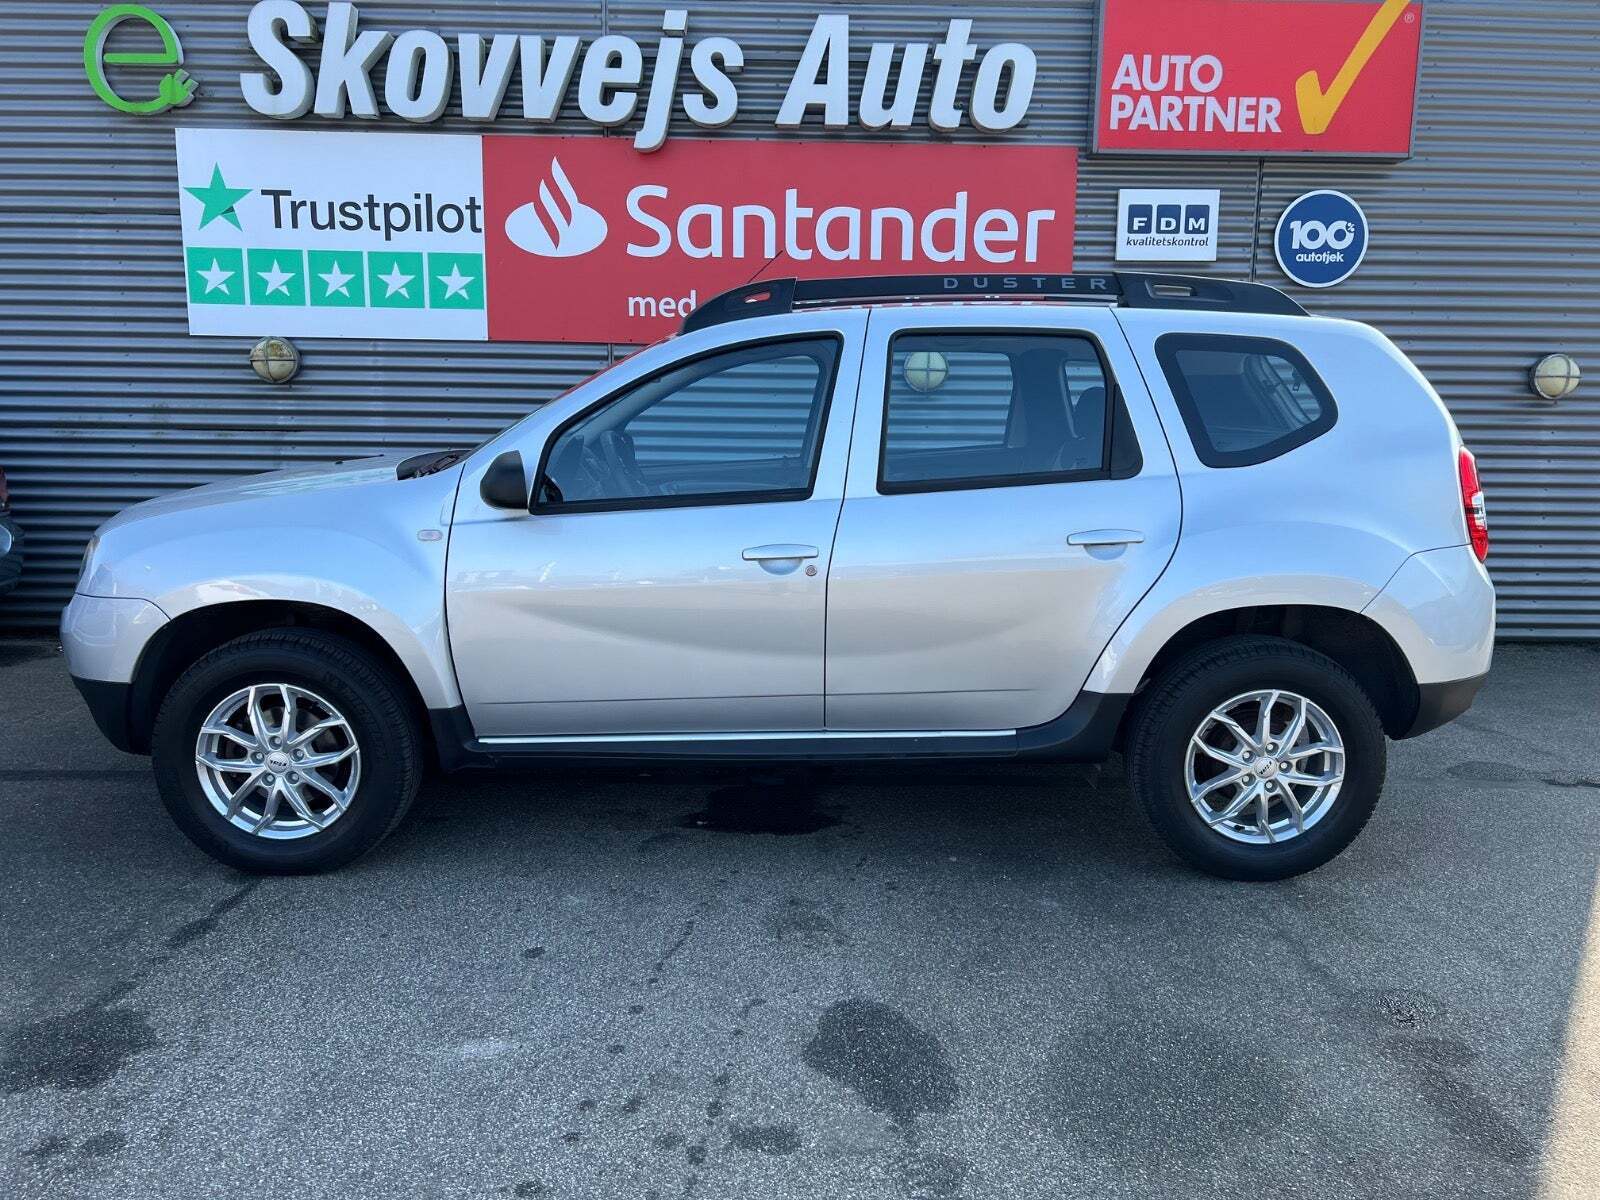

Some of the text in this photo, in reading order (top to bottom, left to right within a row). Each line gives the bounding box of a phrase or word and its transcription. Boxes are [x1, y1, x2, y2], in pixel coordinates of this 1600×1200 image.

[240, 0, 1037, 152] Skovvejs Auto
[1111, 54, 1223, 92] AUTO
[1110, 95, 1282, 133] PARTNER
[261, 189, 483, 241] Trustpilot
[626, 184, 1055, 263] Santander
[1126, 236, 1209, 247] kvalitetskontrol
[943, 277, 1107, 290] DUSTER
[628, 289, 697, 318] med
